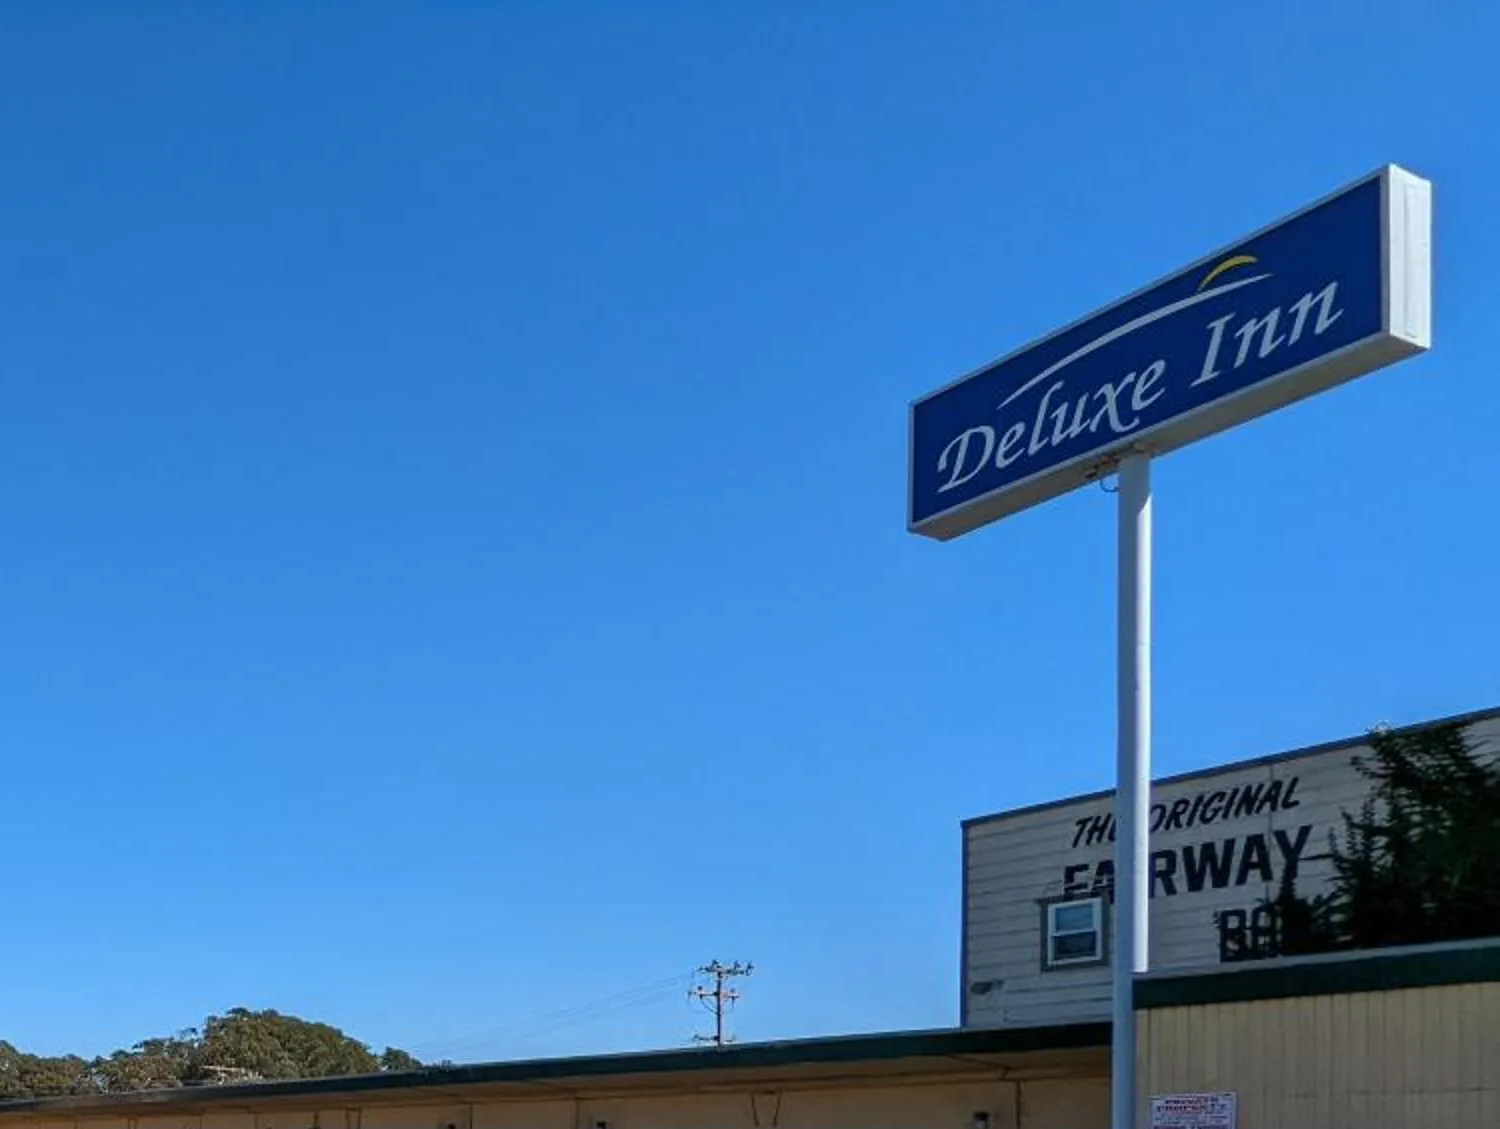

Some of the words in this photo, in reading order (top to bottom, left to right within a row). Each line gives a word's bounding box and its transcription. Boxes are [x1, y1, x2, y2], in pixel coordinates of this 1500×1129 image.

[937, 358, 1166, 493] Deluxe
[1191, 280, 1343, 388] Inn
[1072, 812, 1116, 849] TH
[1150, 777, 1301, 833] ORIGINAL
[1063, 825, 1312, 905] FARWAY
